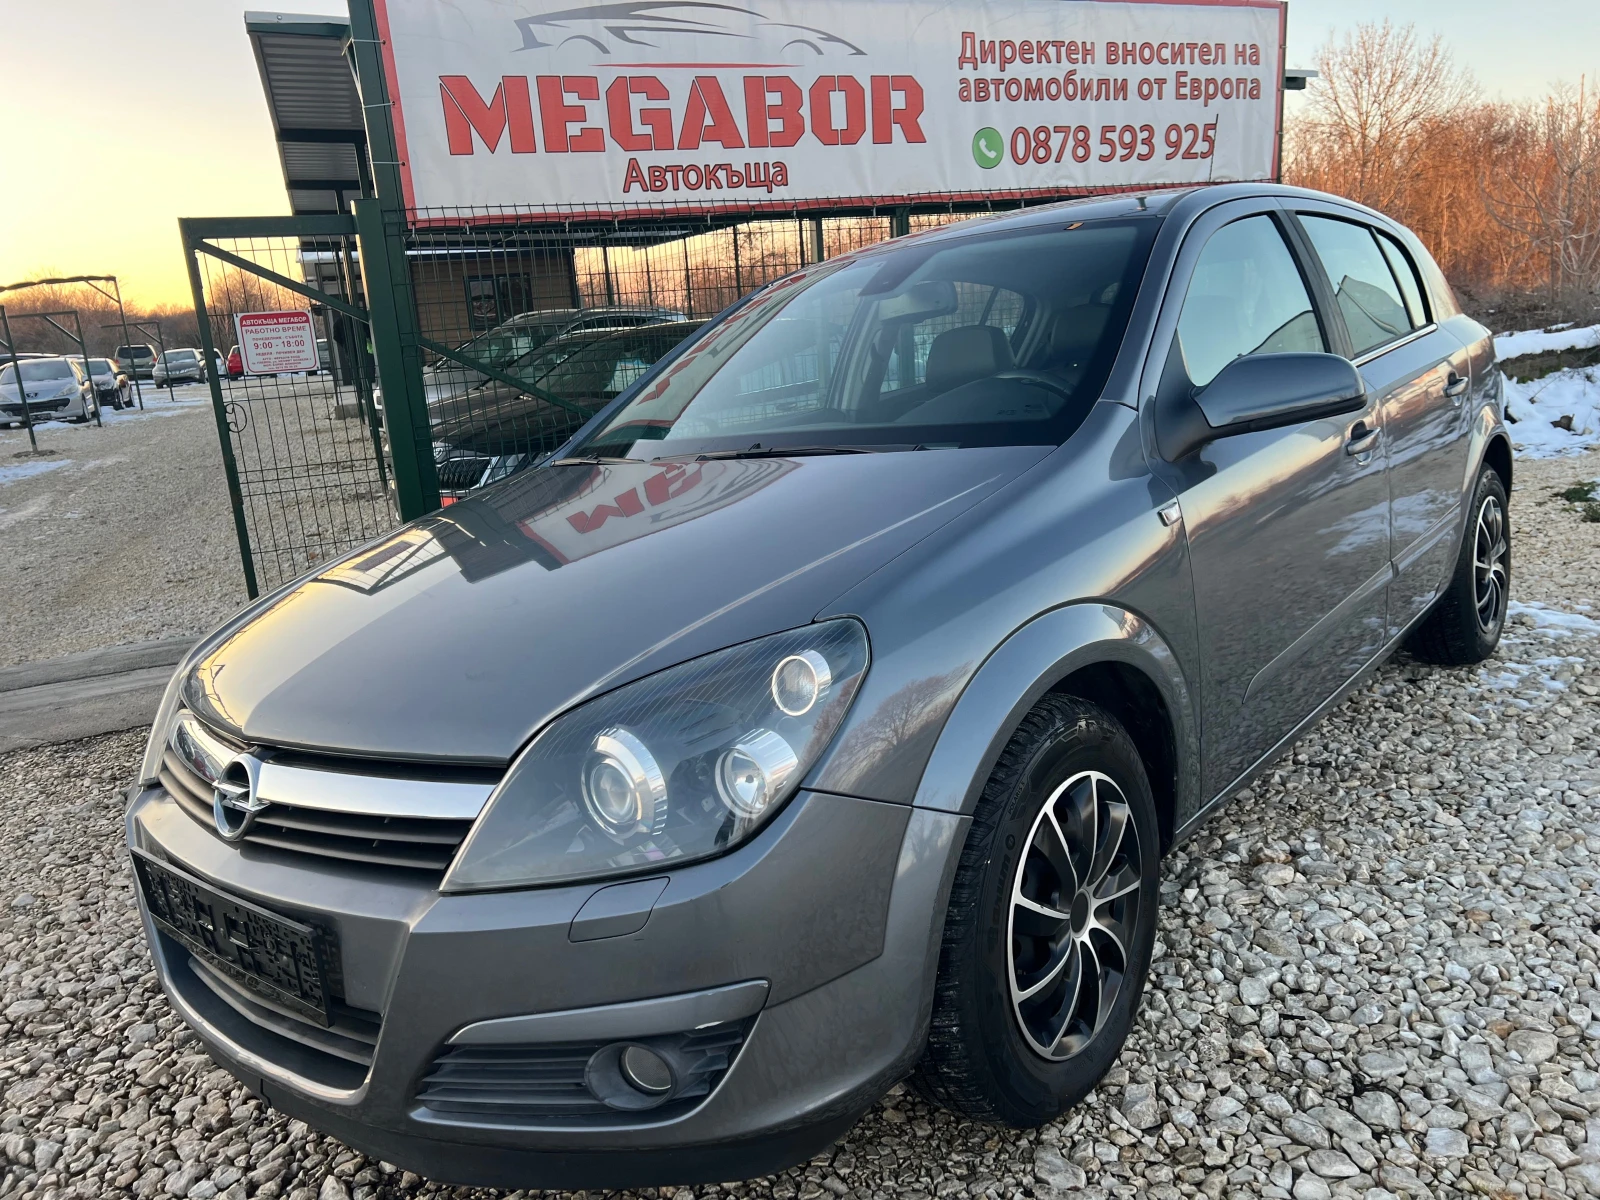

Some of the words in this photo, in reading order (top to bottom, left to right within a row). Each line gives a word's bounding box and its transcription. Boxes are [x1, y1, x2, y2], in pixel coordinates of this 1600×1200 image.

[958, 32, 1096, 72] Директен
[1106, 41, 1226, 66] вносител
[1234, 42, 1261, 66] на
[958, 70, 1128, 102] автомобили
[1137, 77, 1167, 101] от
[1175, 71, 1262, 107] Европа
[439, 75, 927, 156] MEGABOR
[1010, 125, 1091, 165] 0878
[1098, 124, 1156, 162] 593
[1164, 123, 1216, 160] 925
[623, 158, 788, 193] Автокъща
